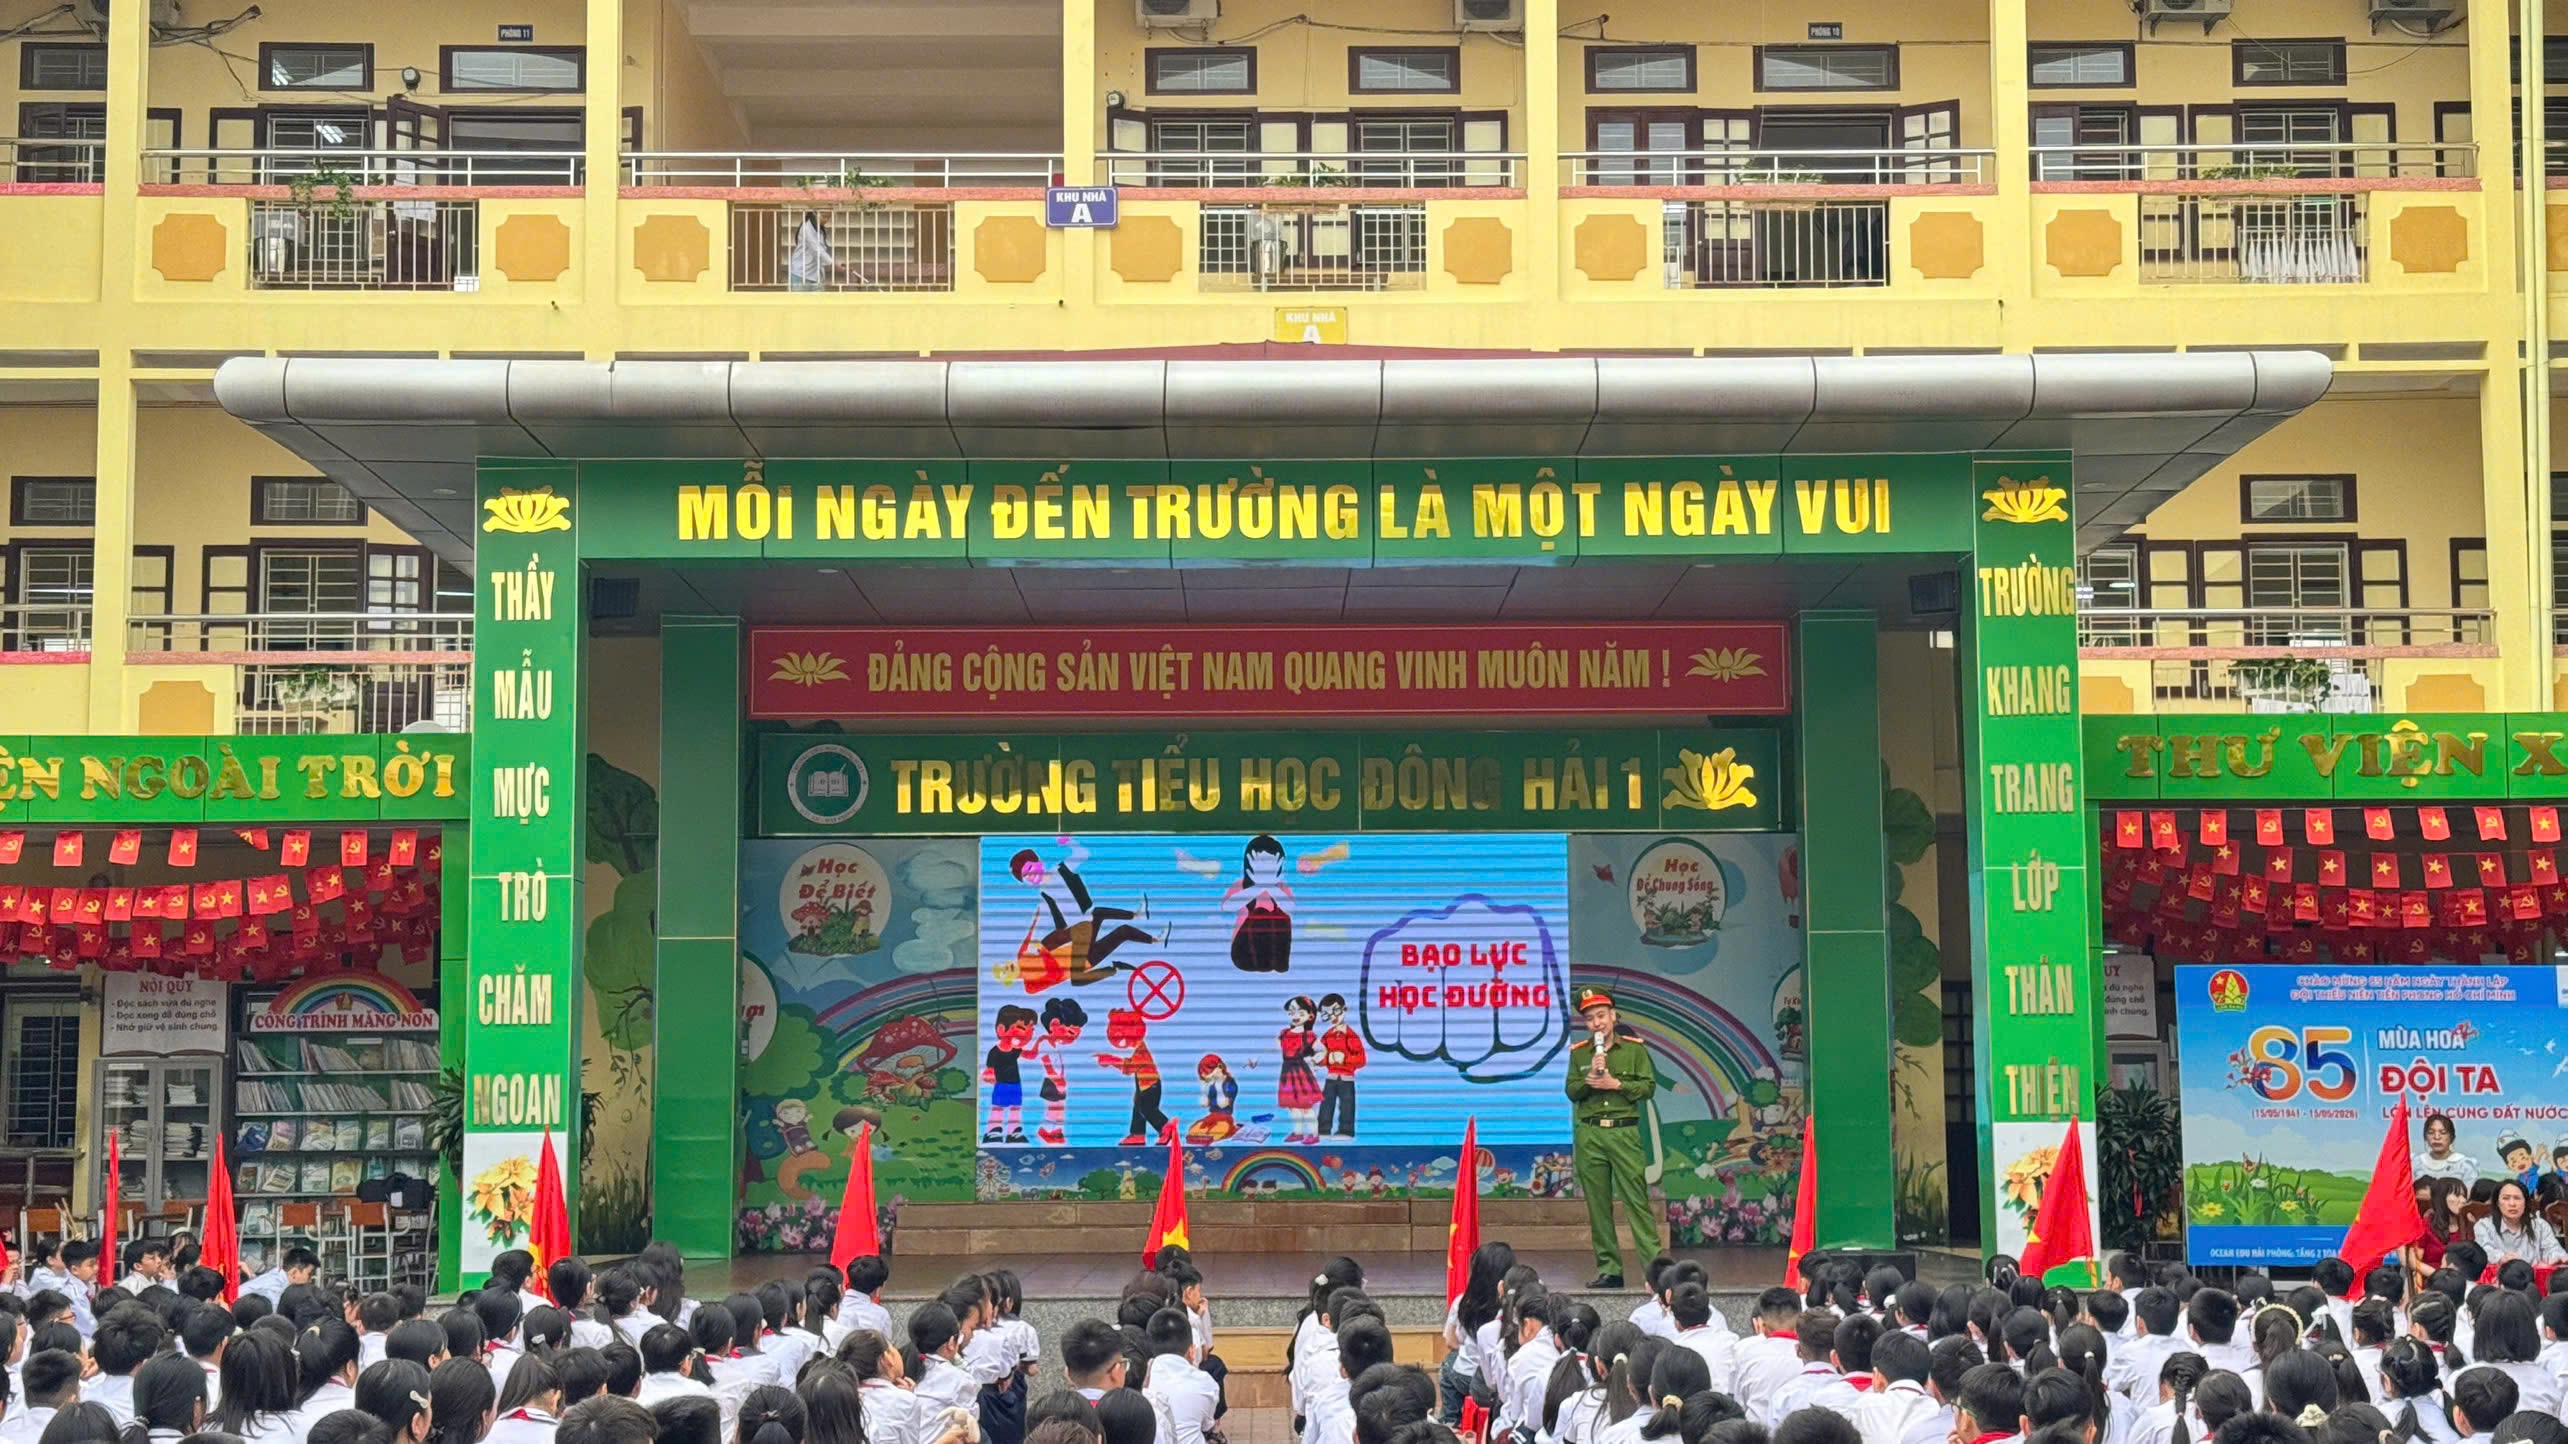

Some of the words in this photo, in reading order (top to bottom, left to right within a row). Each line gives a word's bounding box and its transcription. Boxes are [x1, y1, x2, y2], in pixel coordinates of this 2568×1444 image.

[1056, 191, 1080, 203] KHU
[1082, 189, 1107, 203] NHÀ
[1071, 203, 1093, 223] A
[1285, 310, 1309, 323] KHU
[1303, 325, 1323, 344] A
[678, 460, 793, 540] MỖI
[816, 470, 974, 540] NGÀY
[991, 464, 1111, 540] ĐẾN
[1126, 465, 1359, 540] TRƯỜNG
[1379, 469, 1451, 539] LÀ
[1473, 466, 1602, 550] MỘT
[1624, 465, 1777, 538] NGÀY
[1795, 479, 1891, 537] VUI
[491, 552, 555, 622] THẦY
[1979, 553, 2075, 617] TRƯỜNG
[494, 648, 553, 720] MẪU
[868, 639, 953, 692] ĐẢNG
[963, 644, 1046, 700] CỘNG
[1056, 639, 1119, 692] SẢN
[1129, 643, 1193, 700] VIỆT
[1203, 650, 1272, 691] NAM
[1284, 650, 1386, 695] QUANG
[1396, 649, 1467, 690] VINH
[1478, 641, 1569, 689] MUÔN
[1579, 640, 1650, 689] NĂM
[1986, 665, 2072, 716] KHANG
[79, 744, 281, 800] NGOÀI
[298, 740, 456, 799] TRỜI
[2117, 726, 2280, 777] THƯ
[2298, 719, 2488, 788] VIỆN
[493, 762, 550, 825] MỰC
[890, 742, 1097, 814] TRƯỜNG
[1112, 734, 1220, 814] TIỂU
[1240, 757, 1341, 822] HỌC
[1361, 743, 1500, 811] ĐÔNG
[1523, 738, 1608, 811] HẢI
[1620, 757, 1641, 810] 1
[1990, 762, 2075, 814] TRANG
[816, 858, 858, 878] Học
[1652, 877, 1686, 895] Chung
[1687, 874, 1713, 895] Sống
[1664, 858, 1699, 877] Học
[2012, 849, 2060, 912] LỚP
[499, 857, 548, 922] TRÒ
[799, 879, 830, 899] Để
[832, 880, 876, 899] Biết
[1401, 944, 1461, 972] BẠO
[1470, 941, 1528, 972] LỰC
[2104, 965, 2121, 977] UY
[139, 977, 162, 994] NỘI
[167, 980, 194, 994] QUY
[478, 963, 553, 1025] CHĂM
[1379, 985, 1437, 1015] HỌC
[1445, 977, 1550, 1008] ĐƯỜNG
[2005, 954, 2075, 1017] THÂN
[2290, 987, 2313, 1003] ĐỘI
[2314, 986, 2346, 1001] THIẾU
[2347, 987, 2375, 1001] NIÊN
[2401, 988, 2443, 1001] PHONG
[2486, 989, 2516, 1001] MINH
[2296, 973, 2331, 987] CHÀO
[2383, 973, 2409, 987] NĂM
[2411, 973, 2443, 987] NGÀY
[2447, 973, 2484, 987] THÀNH
[117, 999, 134, 1009] Đọc
[137, 1011, 159, 1020] xong
[255, 1010, 296, 1028] CÔNG
[301, 1010, 348, 1028] TRÌNH
[352, 1009, 396, 1028] MĂNG
[401, 1012, 433, 1028] NON
[2378, 1024, 2421, 1049] MÙA
[2425, 1029, 2465, 1049] HOA
[2249, 1025, 2358, 1102] 85
[2380, 1058, 2447, 1101] ĐỘI
[2455, 1065, 2501, 1094] TA
[473, 1073, 561, 1126] NGOAN
[2004, 1056, 2081, 1122] THIỆN
[2445, 1104, 2489, 1119] CÙNG
[2493, 1103, 2521, 1119] ĐẤT
[2525, 1104, 2568, 1119] NƯỚC
[2210, 1248, 2234, 1258] OCEAN
